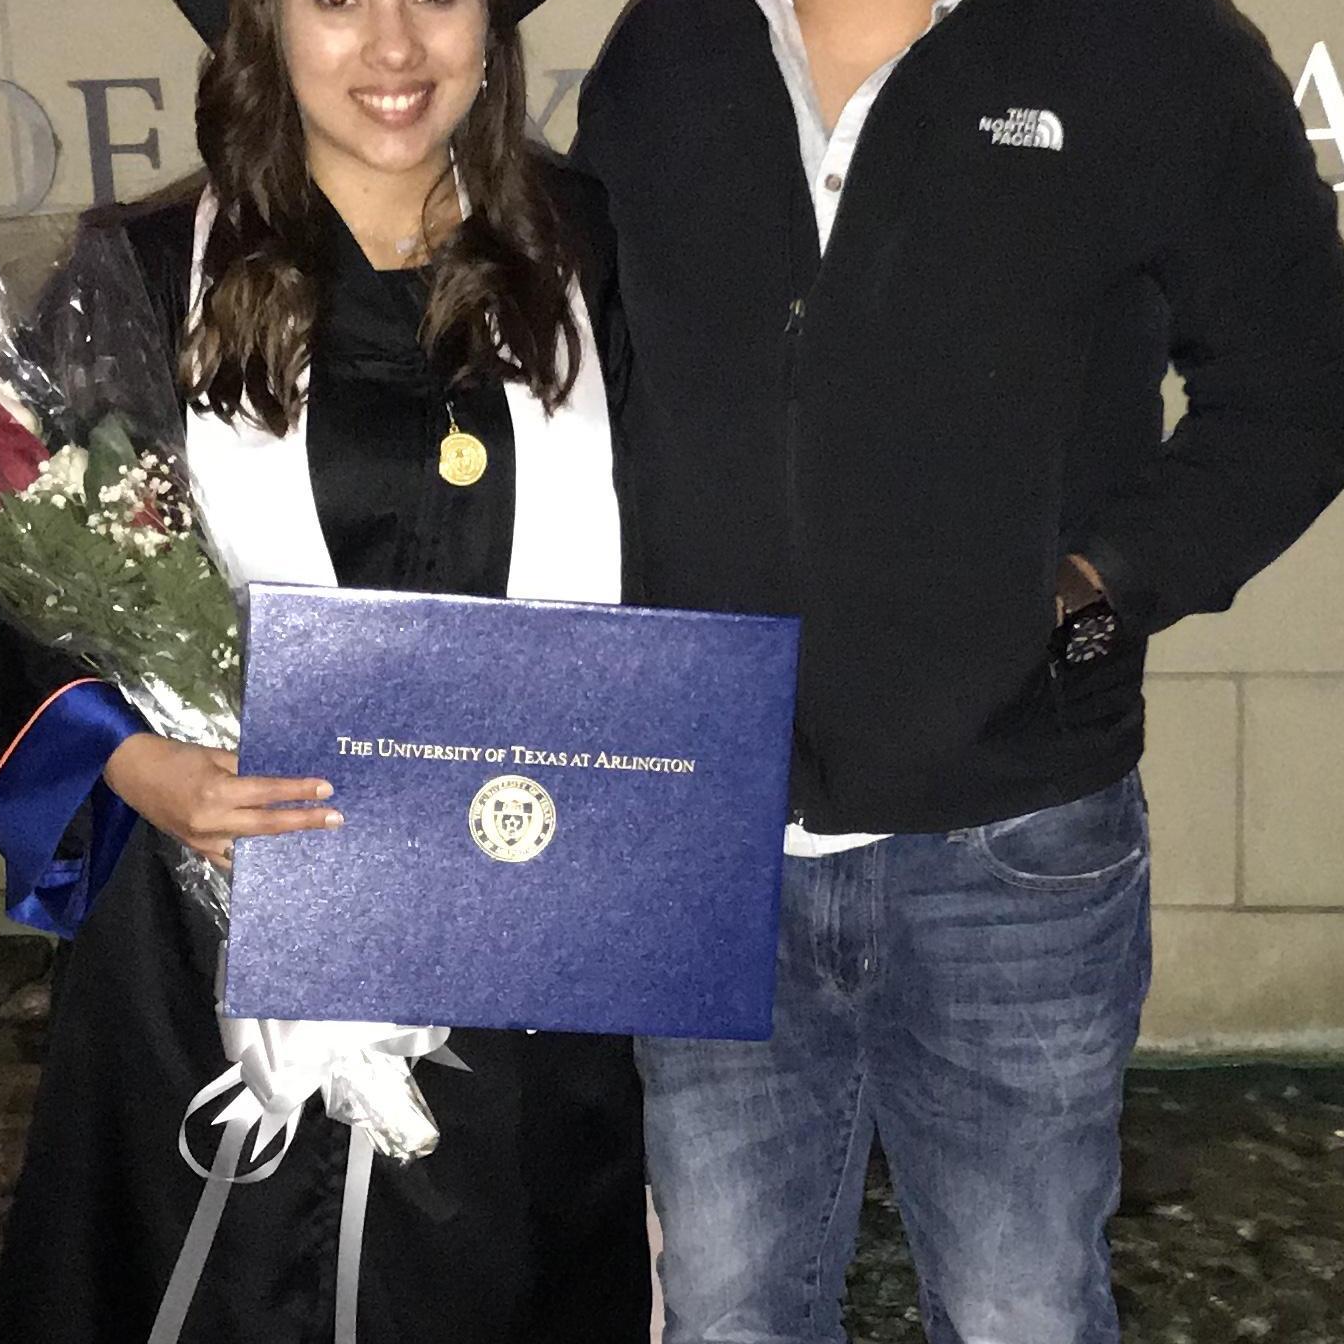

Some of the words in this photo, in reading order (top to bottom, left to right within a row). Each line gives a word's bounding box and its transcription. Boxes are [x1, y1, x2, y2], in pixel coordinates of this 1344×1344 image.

[336, 736, 373, 757] THE
[377, 738, 482, 762] UNIVERSITY
[484, 747, 507, 764] OF
[511, 745, 568, 767] TEXAS
[569, 753, 592, 768] AT
[593, 751, 696, 773] ARLINGTON
